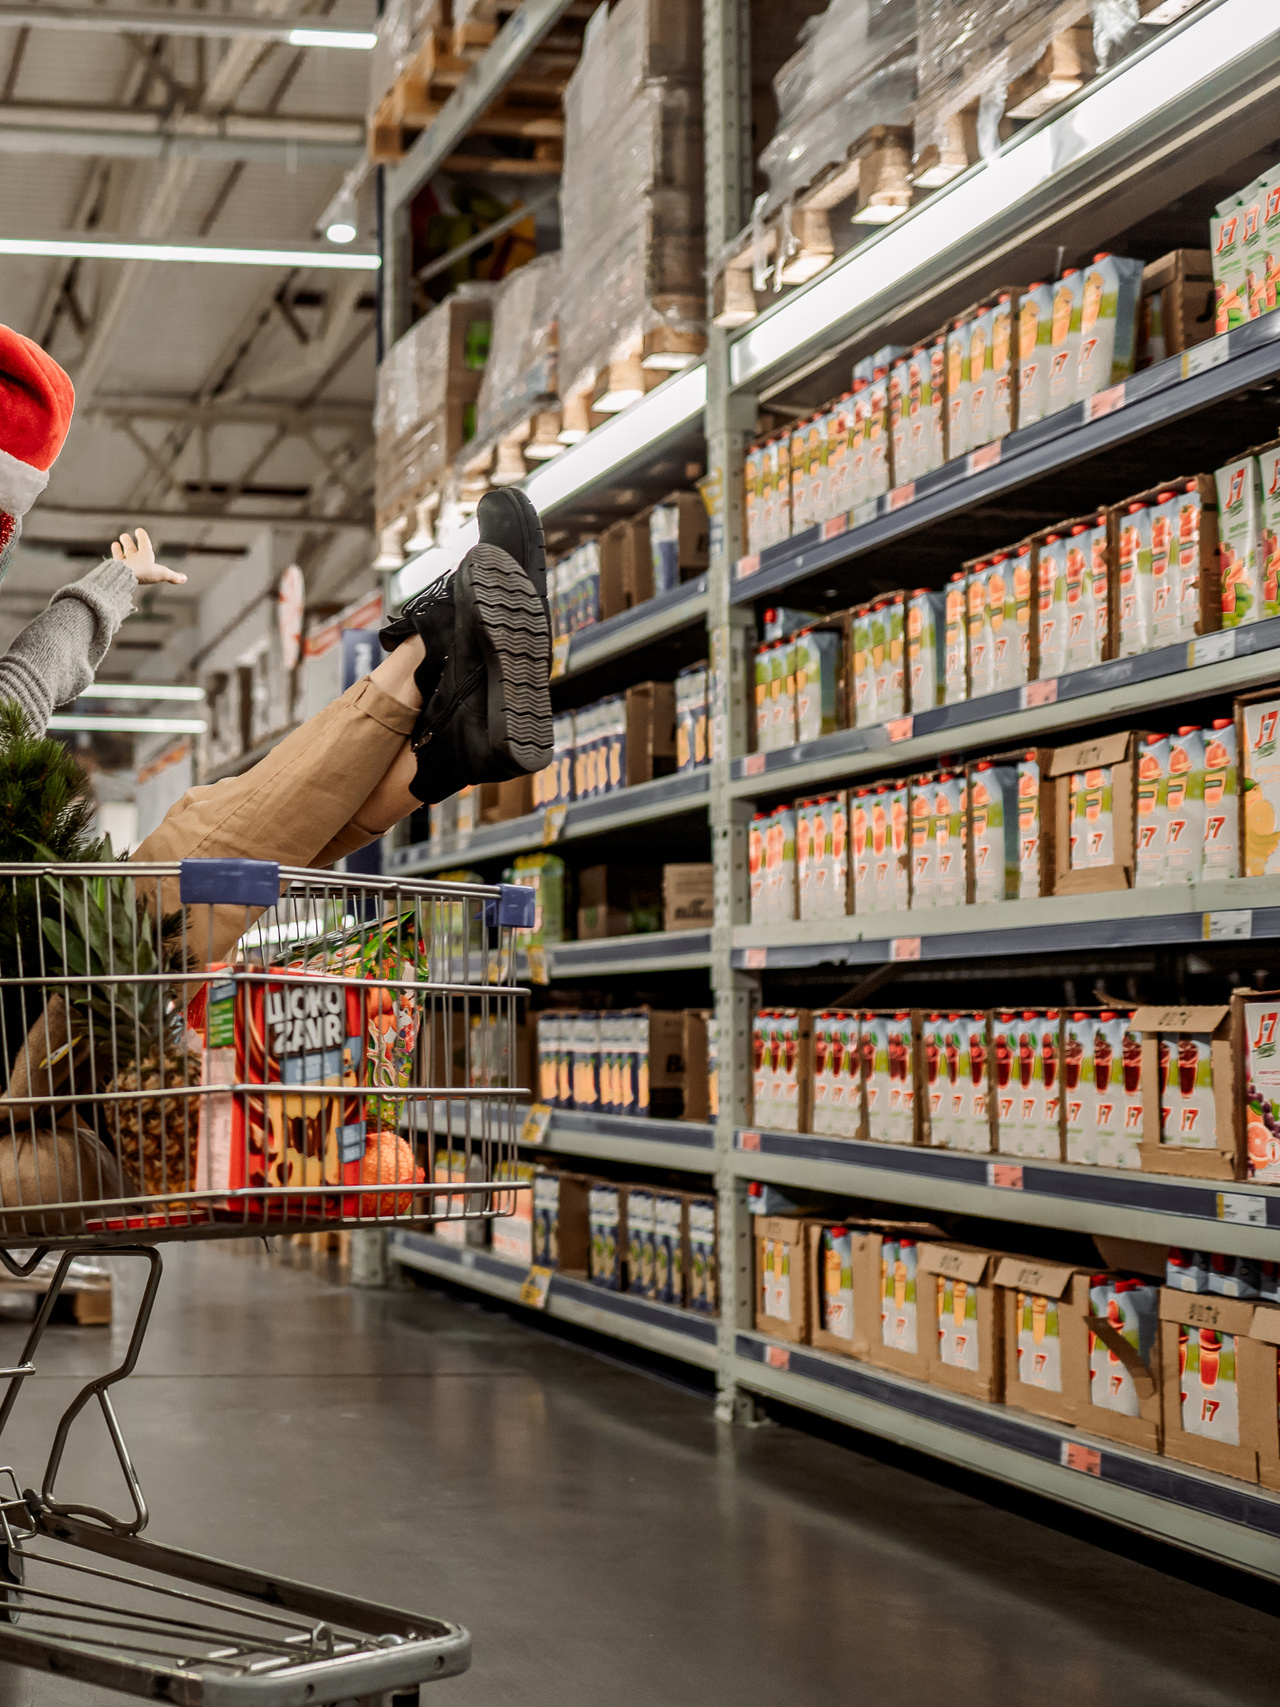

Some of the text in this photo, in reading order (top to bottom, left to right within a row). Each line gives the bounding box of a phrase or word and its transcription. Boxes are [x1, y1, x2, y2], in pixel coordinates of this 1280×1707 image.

[1216, 217, 1238, 253] J7
[1243, 205, 1259, 242] J7
[1226, 469, 1246, 509] J7
[1254, 711, 1279, 748] J7
[1204, 817, 1225, 840] J7
[1253, 1013, 1278, 1048] J7
